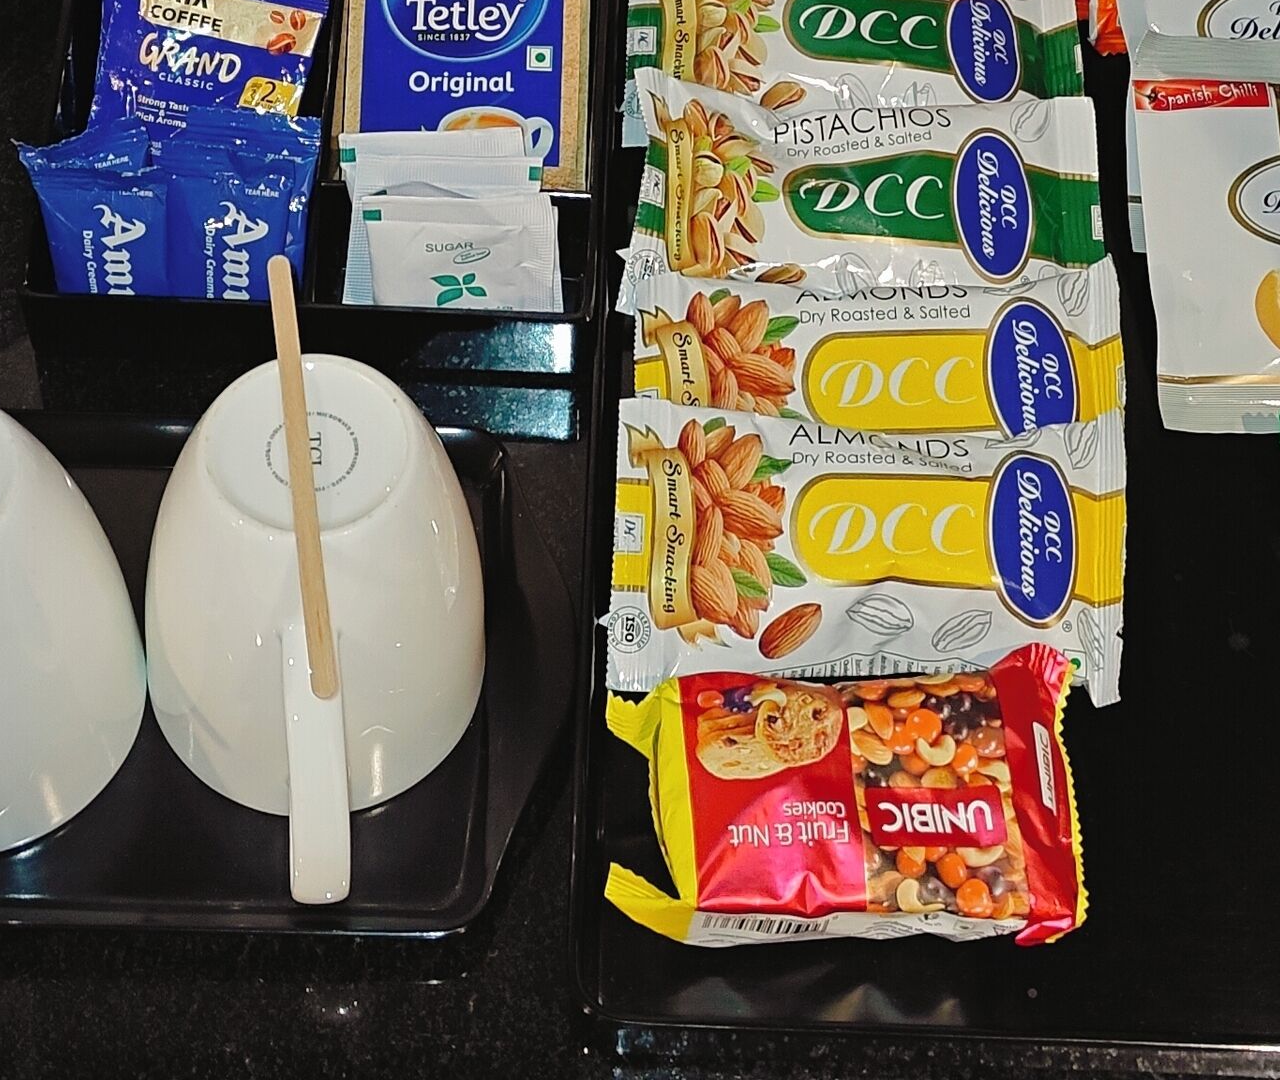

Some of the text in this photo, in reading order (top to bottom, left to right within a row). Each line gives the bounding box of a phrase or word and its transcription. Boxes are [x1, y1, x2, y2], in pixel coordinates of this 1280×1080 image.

[417, 33, 446, 42] SINCE
[799, 4, 939, 50] DCC
[969, 0, 992, 87] Delicious
[139, 31, 242, 83] GRAND
[993, 29, 1009, 65] DCC
[158, 72, 215, 91] CLASSIC
[408, 70, 515, 98] Original
[1157, 83, 1259, 110] Spanish Chilli
[136, 94, 166, 109] Strong
[156, 116, 187, 129] Aroma
[774, 107, 952, 146] PISTACHIOS
[787, 130, 933, 159] Dry Roasted Salted
[799, 172, 946, 221] DCC
[976, 149, 994, 261] Delicious
[1001, 185, 1017, 230] DCC
[82, 230, 93, 259] Dairy
[425, 241, 474, 253] SUGAR
[799, 305, 971, 326] Dry Roasted & Salted
[672, 332, 696, 385] Smart
[1012, 319, 1040, 432] Delicious
[1042, 352, 1064, 400] DCC
[820, 357, 979, 409] DCC
[792, 451, 895, 467] Dry Roasted
[661, 458, 685, 614] Smart Snacking
[809, 502, 976, 556] DCC
[1016, 469, 1036, 603] Delicious
[1045, 510, 1063, 564] DCC
[624, 616, 636, 643] ISO
[782, 800, 846, 818] Cookies
[881, 799, 994, 834] UNIBIC
[728, 822, 849, 847] Fruit & Nut
